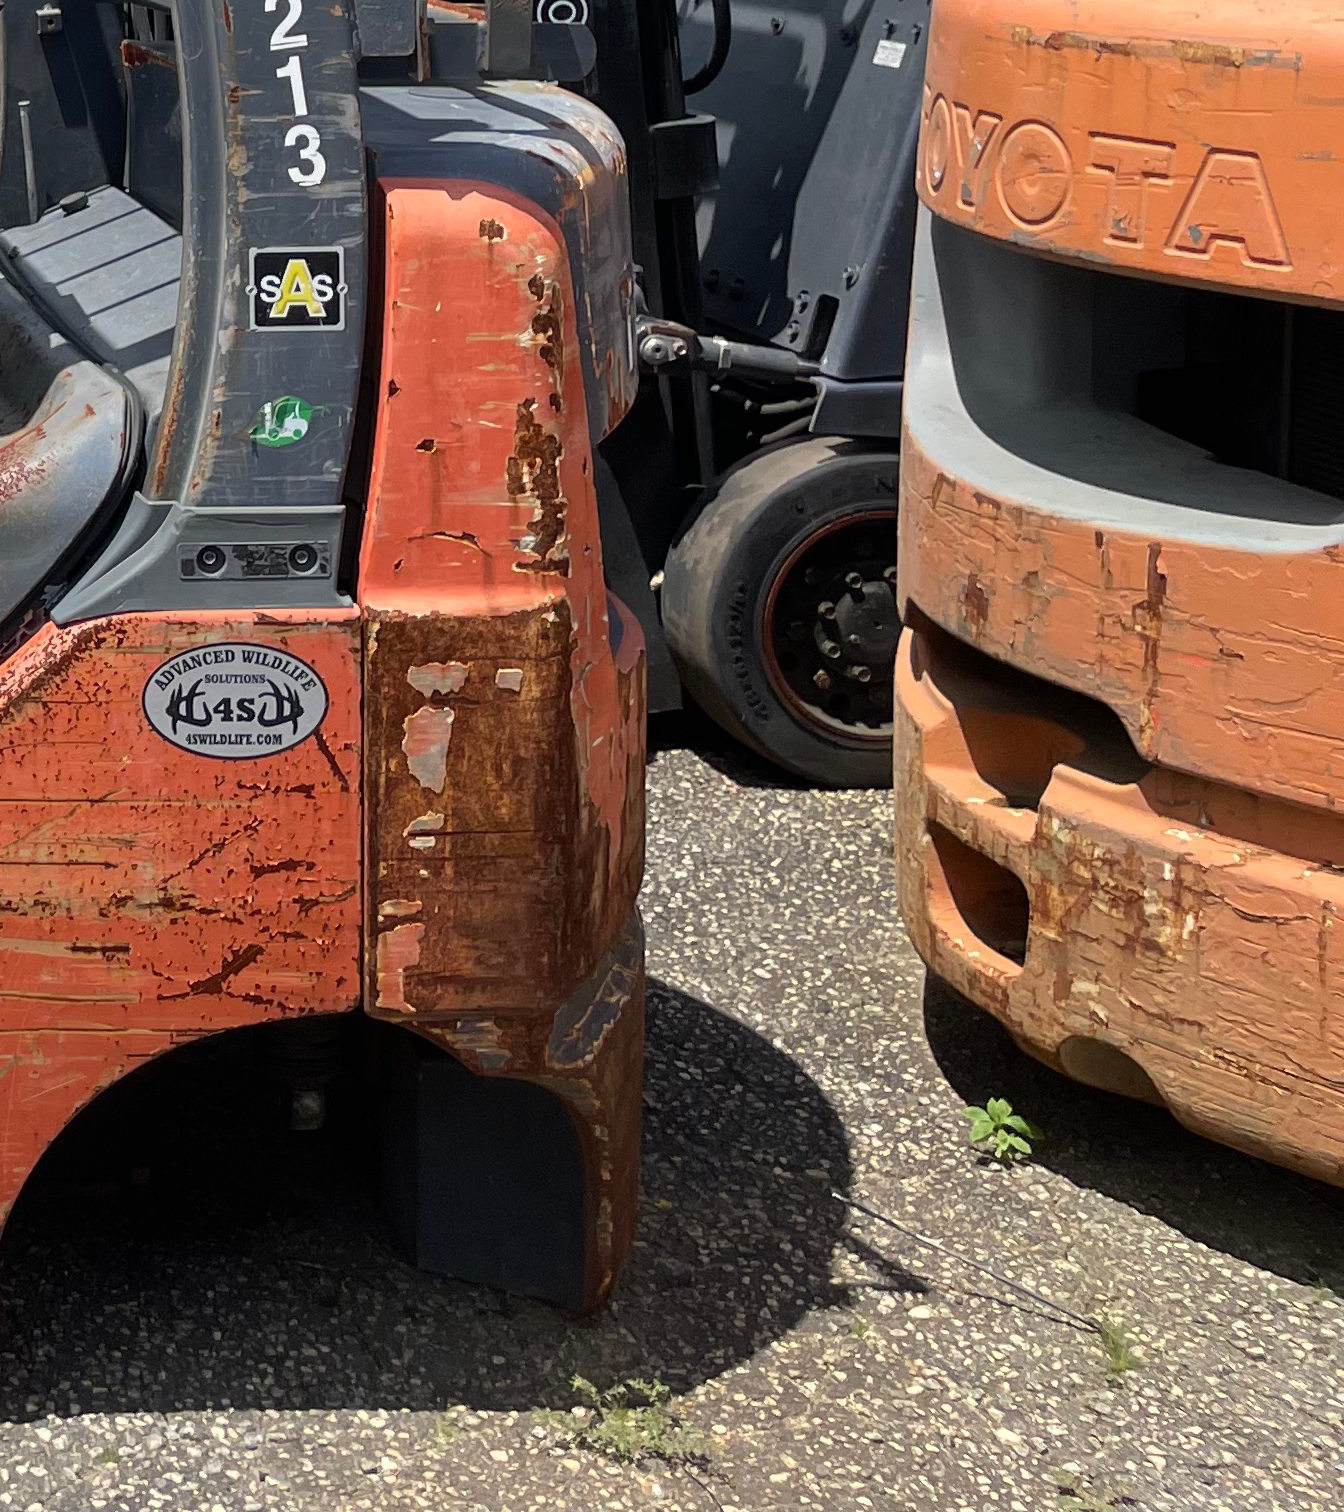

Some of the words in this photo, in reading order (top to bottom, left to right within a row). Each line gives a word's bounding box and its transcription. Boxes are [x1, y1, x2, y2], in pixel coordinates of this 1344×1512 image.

[917, 85, 1293, 272] OYOTA
[153, 649, 236, 692] ADVANCED
[241, 649, 317, 693] WILDLIFE
[204, 674, 266, 685] SOLUTIONS
[213, 697, 256, 723] 4S
[185, 733, 283, 746] 4SWILDLIFE.COM
